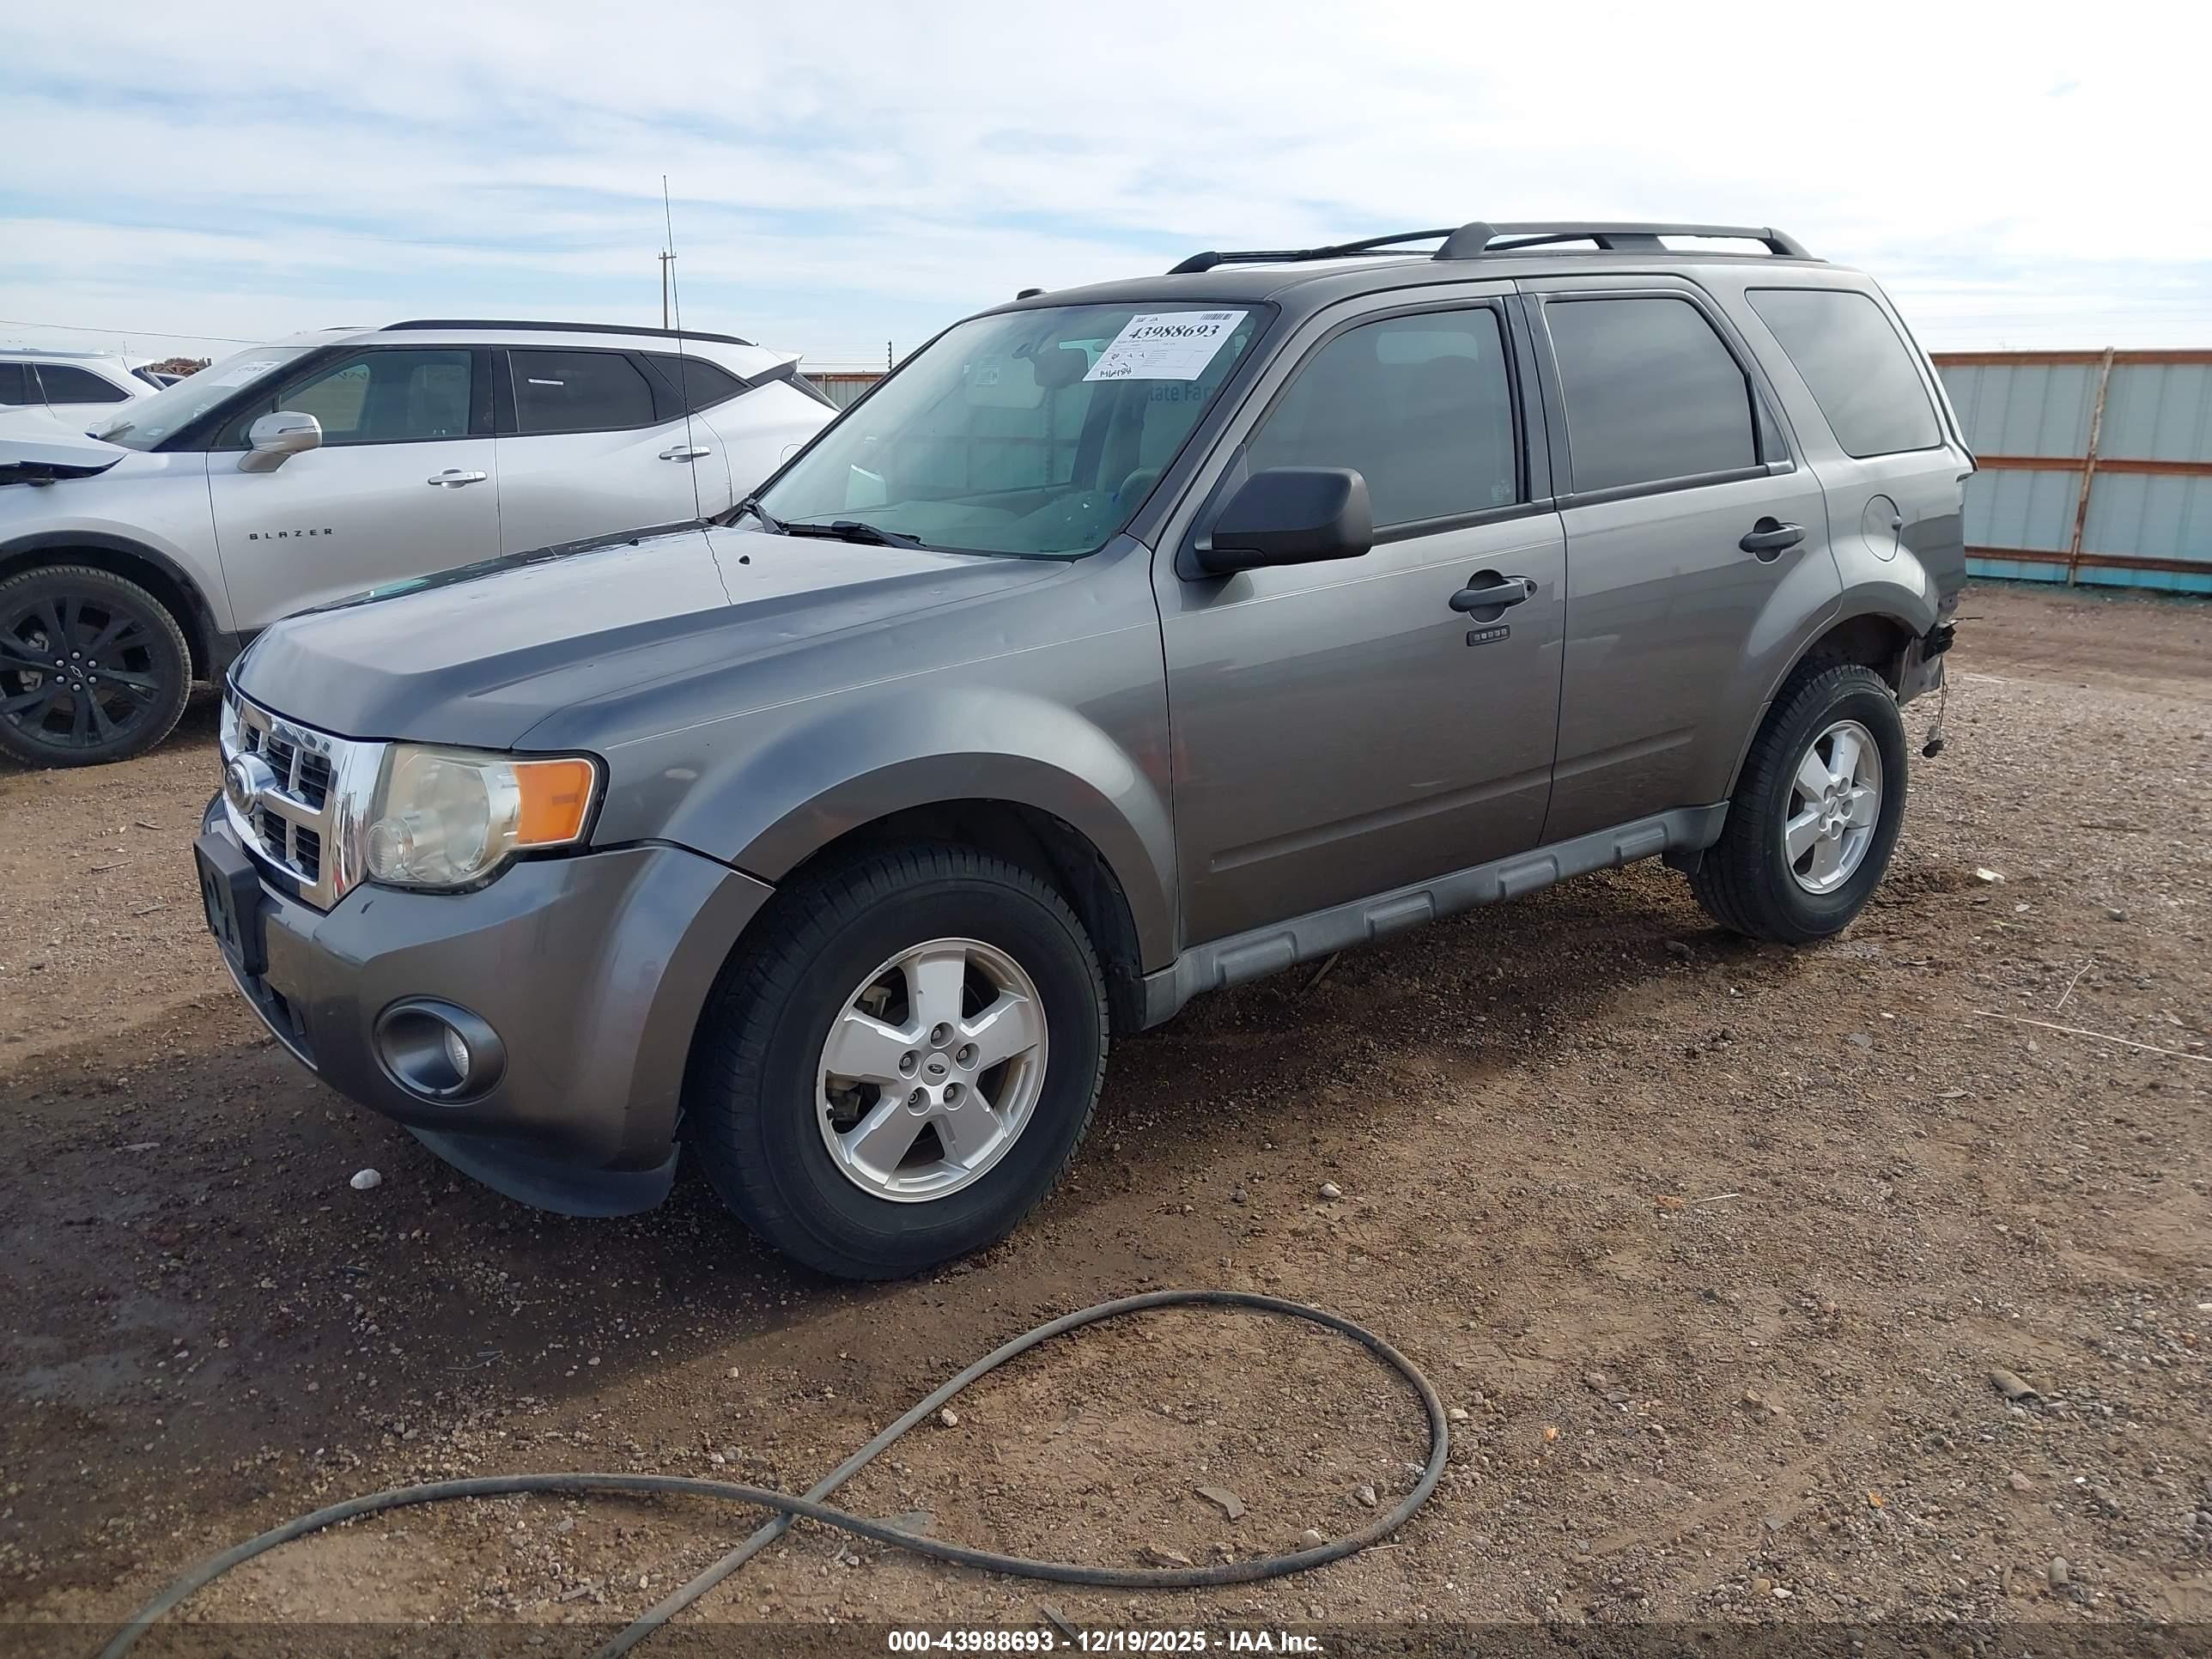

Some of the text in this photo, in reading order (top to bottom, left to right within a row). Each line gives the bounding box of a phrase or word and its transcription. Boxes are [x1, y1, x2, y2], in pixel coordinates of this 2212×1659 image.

[1128, 325, 1220, 338] 43988693
[1149, 382, 1212, 401] tate Far
[249, 528, 332, 540] BLAZER
